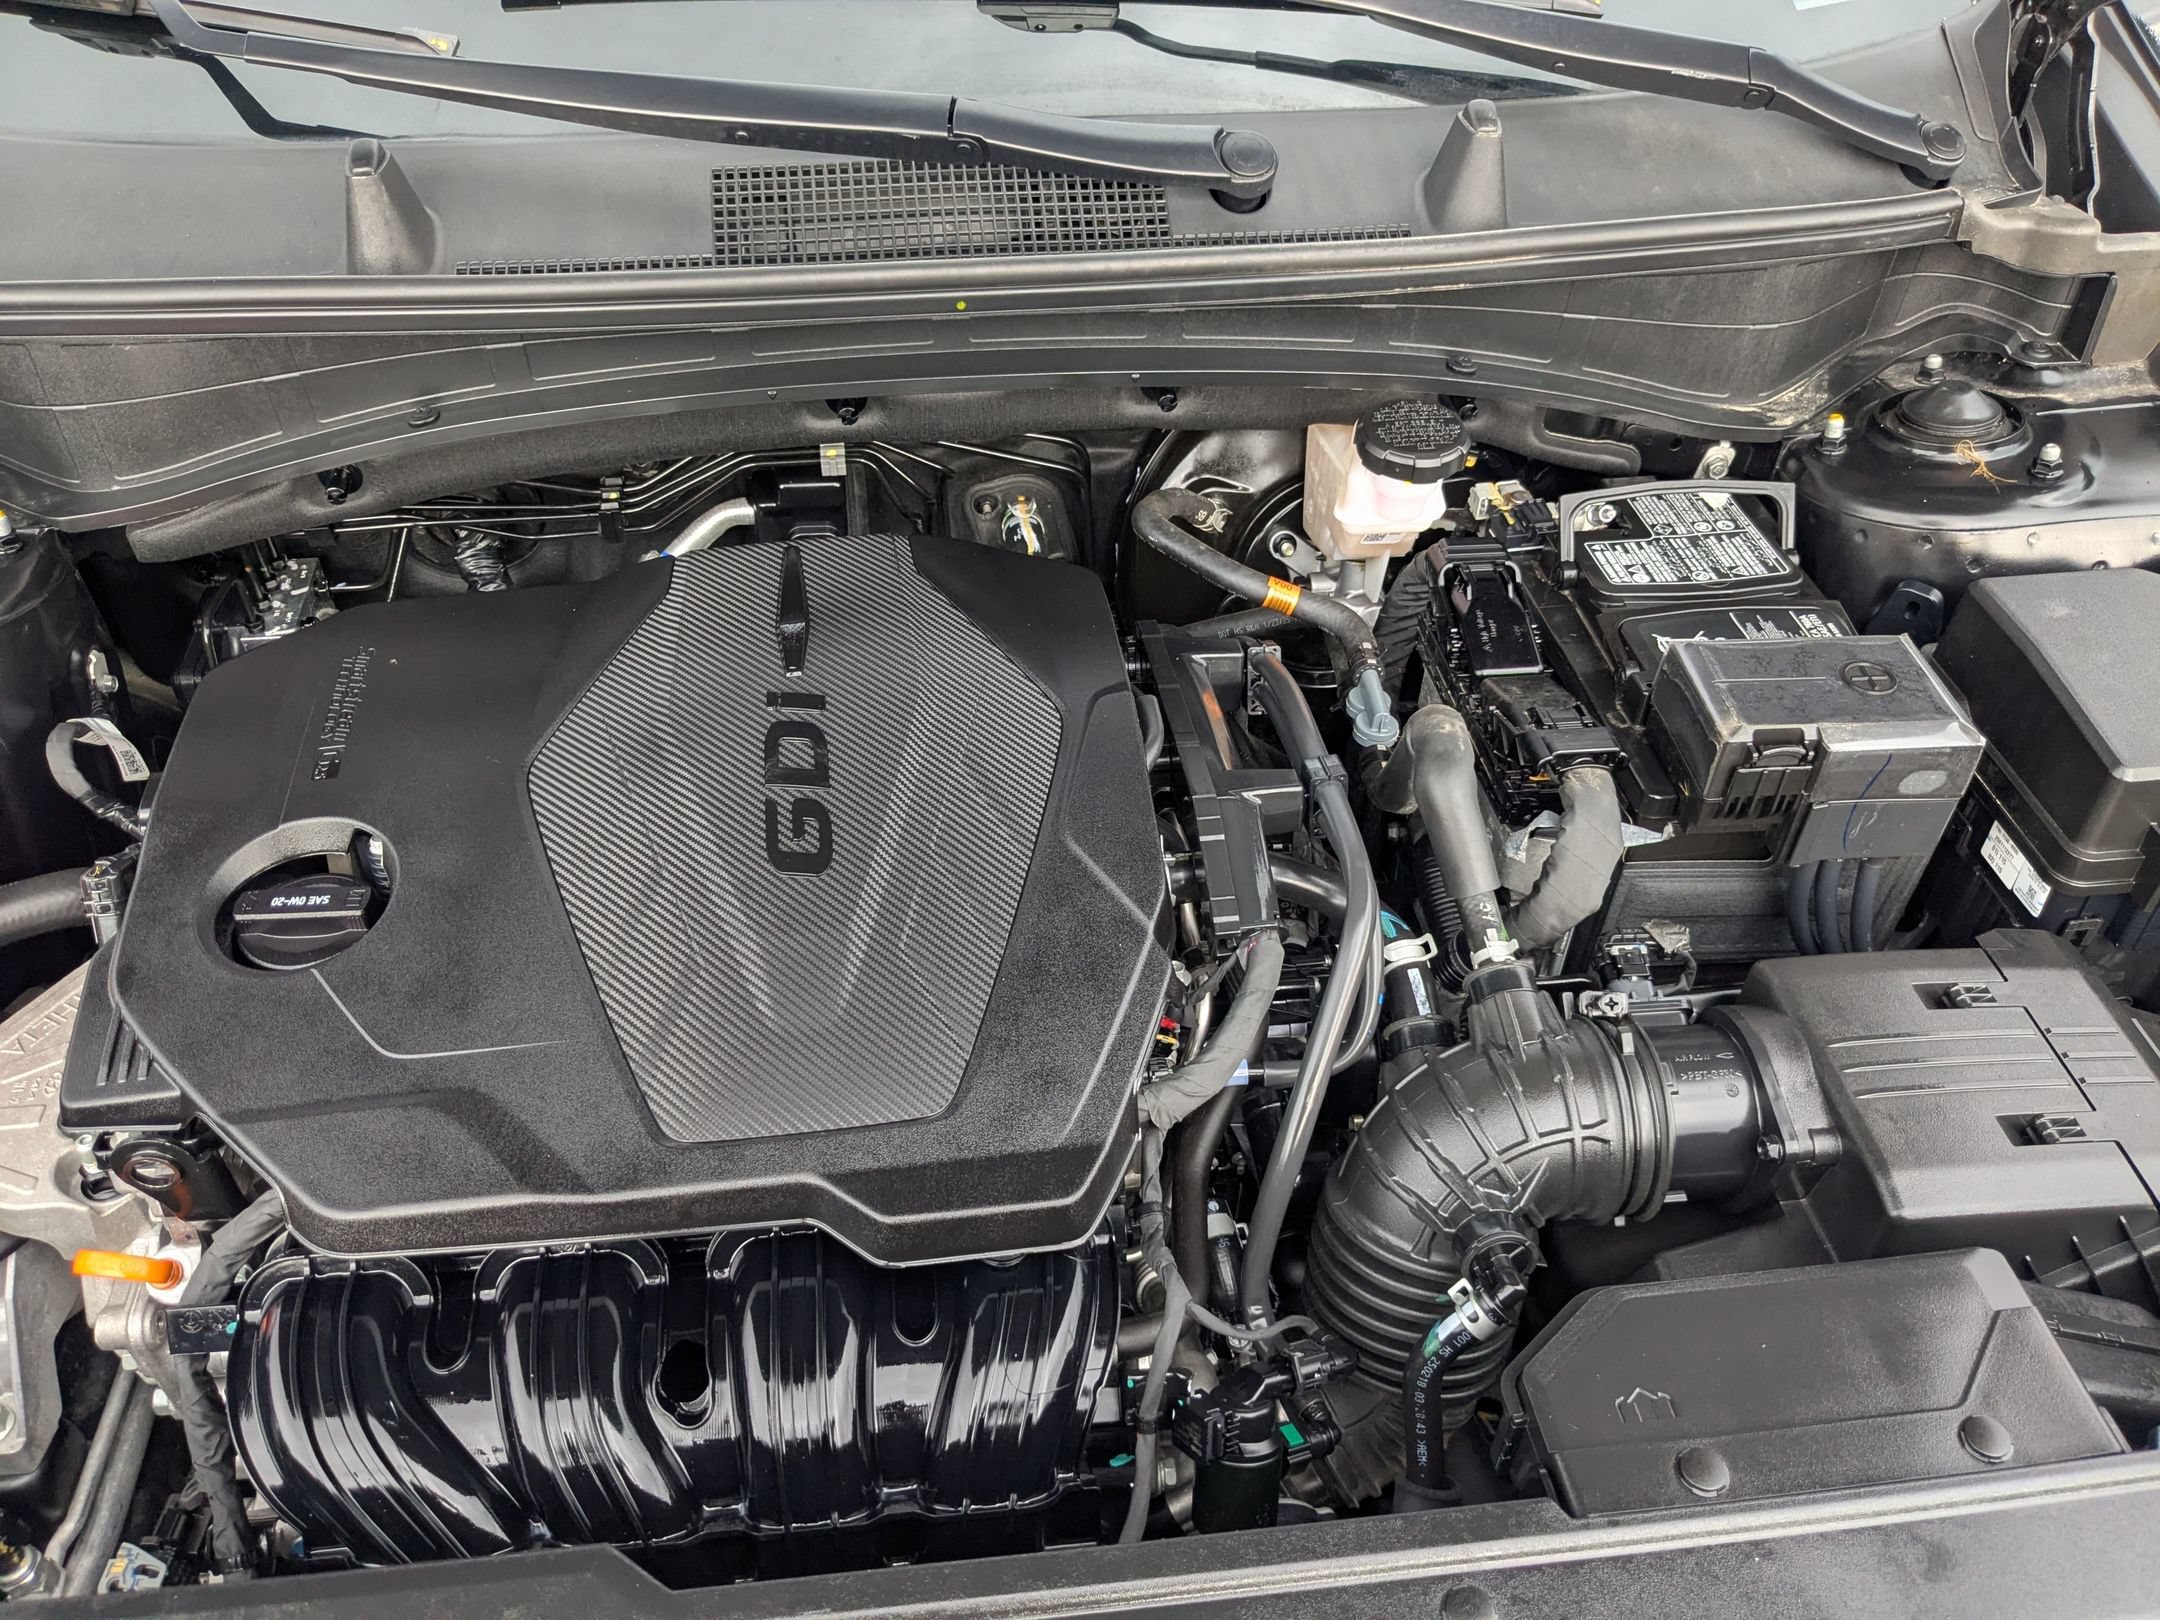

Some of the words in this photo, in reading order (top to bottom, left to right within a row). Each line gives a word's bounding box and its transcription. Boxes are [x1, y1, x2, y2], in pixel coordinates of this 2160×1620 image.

[319, 656, 356, 743] TECHNOLOGY
[333, 646, 377, 743] Smartstream
[270, 896, 307, 907] 0W-20
[308, 895, 331, 905] SAE
[0, 994, 80, 1055] HETA
[1439, 1344, 1454, 1359] HS
